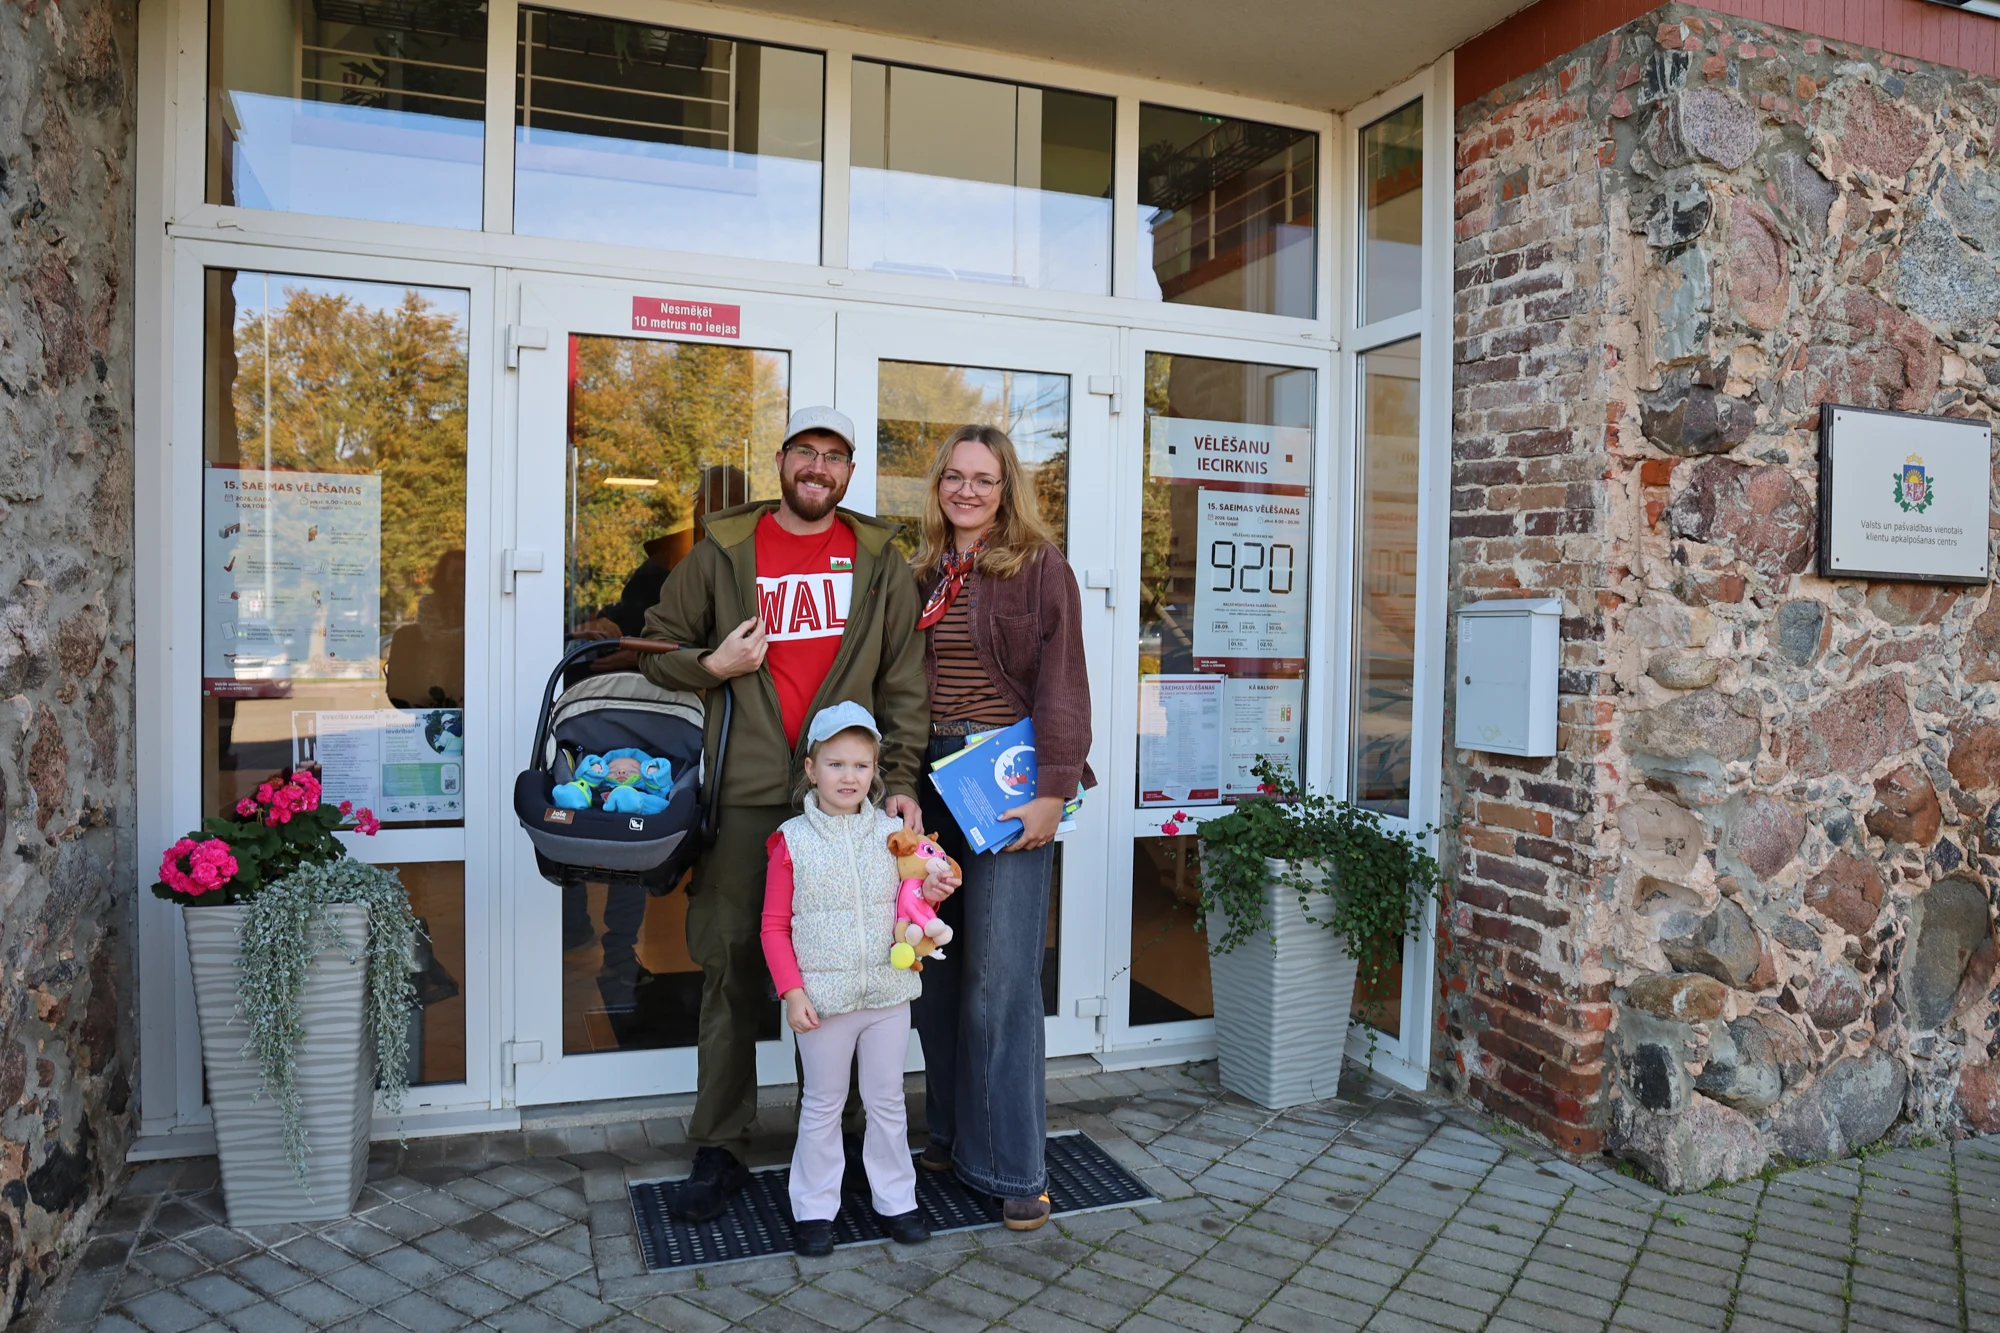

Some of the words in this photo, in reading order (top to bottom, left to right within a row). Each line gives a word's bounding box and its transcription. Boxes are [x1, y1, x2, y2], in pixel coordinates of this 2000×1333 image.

[660, 302, 712, 319] Nesmēķēt
[635, 316, 648, 327] 10
[650, 318, 686, 330] metrus
[690, 322, 702, 332] no
[706, 322, 737, 336] ieejas
[1194, 434, 1270, 455] VĒLĒŠANU
[1198, 458, 1268, 474] IECIRKNIS
[224, 480, 239, 490] 15.
[296, 482, 362, 494] VĒLĒŠANAS
[1208, 502, 1218, 510] 15.
[1219, 503, 1254, 512] SAEIMAS
[1255, 504, 1300, 516] VĒLĒŠANAS
[1860, 520, 1882, 530] Valsts
[1894, 521, 1932, 532] pašvaldības
[1934, 526, 1963, 535] vienotais
[1866, 532, 1889, 542] klientu
[1891, 534, 1936, 545] apkalpošanas
[1937, 538, 1958, 546] centrs
[1212, 540, 1294, 594] 920
